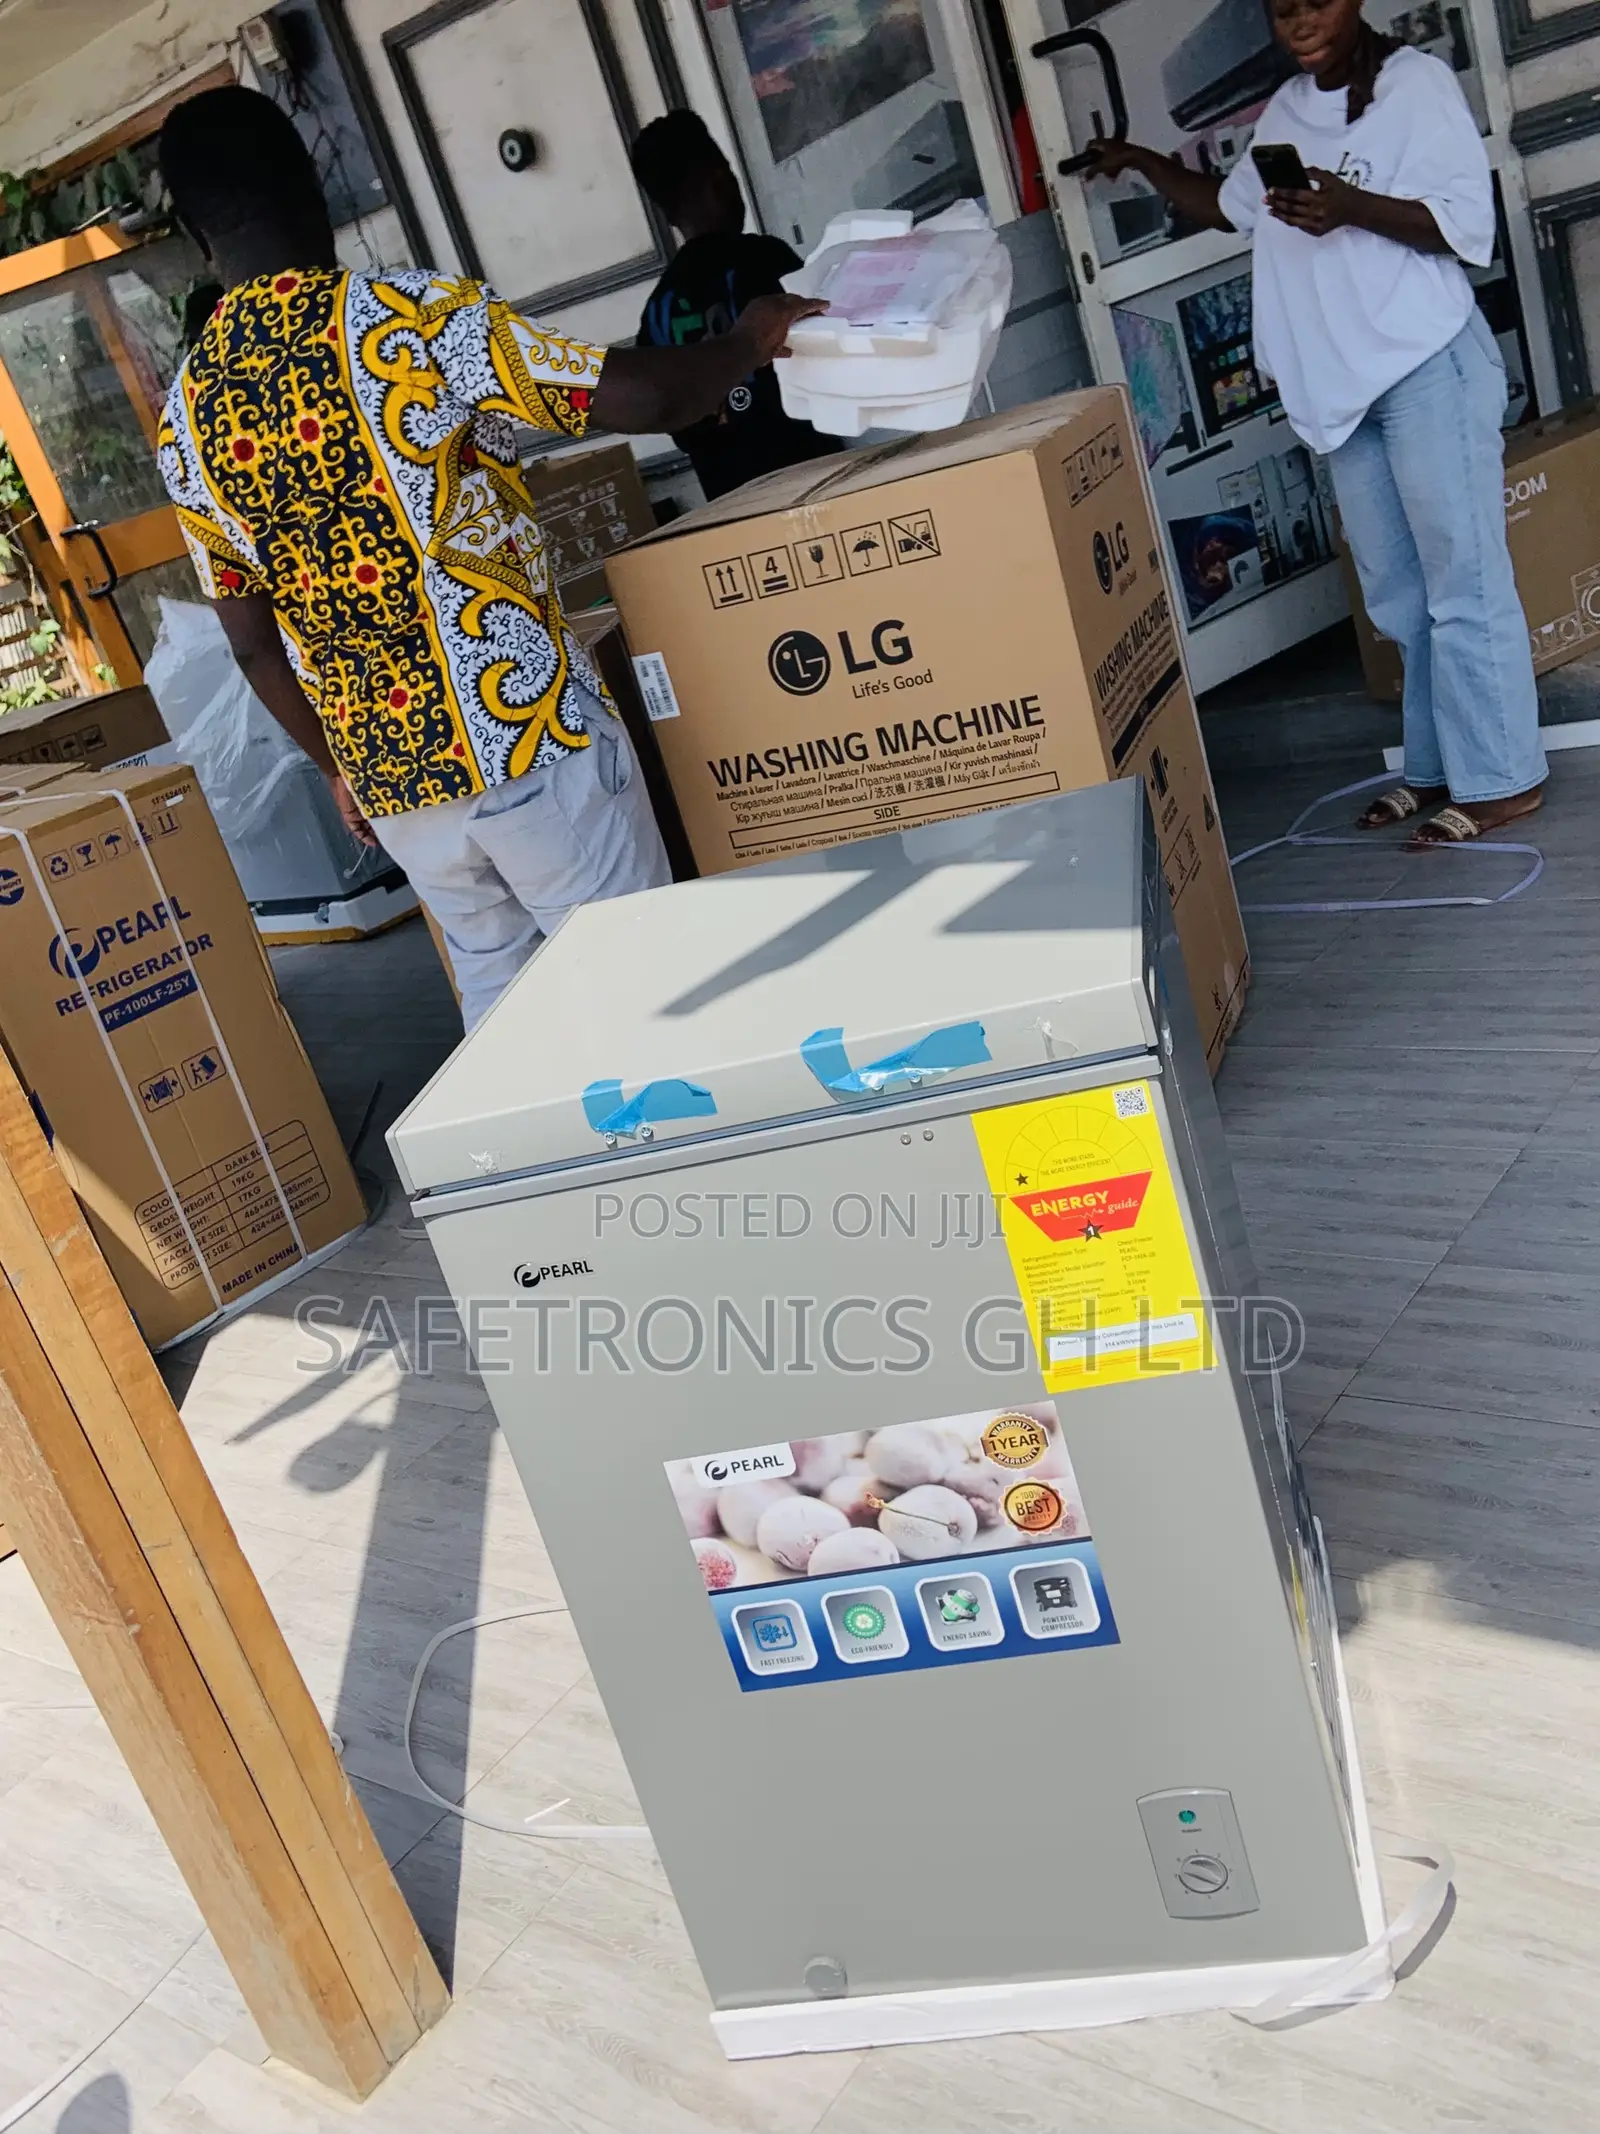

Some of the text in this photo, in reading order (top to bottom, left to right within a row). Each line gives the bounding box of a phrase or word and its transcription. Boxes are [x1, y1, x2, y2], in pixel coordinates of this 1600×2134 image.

[1107, 521, 1130, 572] LG
[765, 556, 778, 574] 4
[837, 619, 914, 675] LG
[1093, 632, 1133, 701] WASHING
[852, 668, 934, 699] Life's Good
[707, 695, 1045, 787] WASHING MACHINE
[781, 777, 817, 789] Lavadora
[823, 768, 860, 781] Lavatrice
[866, 755, 931, 773] Waschmaschine
[976, 742, 987, 752] de
[988, 738, 1012, 749] Lavar
[1013, 732, 1041, 743] Roupa
[785, 788, 823, 802] машина
[829, 782, 853, 794] Pralka
[903, 765, 943, 780] машина
[963, 754, 991, 770] yuvish
[992, 747, 1033, 763] mashinasi
[783, 802, 820, 815] машина
[826, 796, 850, 808] Mesin
[953, 773, 970, 785] Máy
[874, 805, 900, 820] SIDE
[104, 975, 191, 1025] PF-100LF-25Y
[224, 1155, 250, 1173] DARK
[231, 1170, 255, 1188] 19KG
[1030, 1190, 1110, 1217] ENERGY
[1107, 1198, 1140, 1215] guide
[156, 1233, 176, 1250] NET
[238, 1186, 262, 1203] 17KG
[222, 1242, 300, 1293] MADE IN CHINA
[540, 1261, 594, 1280] PEARL
[990, 1420, 1033, 1437] WARRANTY
[997, 1433, 1040, 1450] YEAR
[731, 1455, 784, 1474] PEARL
[997, 1447, 1039, 1465] WARRANTY
[1015, 1498, 1051, 1516] BEST
[943, 1630, 992, 1643] ENERGY SAVING
[1041, 1621, 1084, 1633] COMPRESSOR
[851, 1643, 894, 1655] ECO-FRIENDLY
[760, 1658, 775, 1668] FAST
